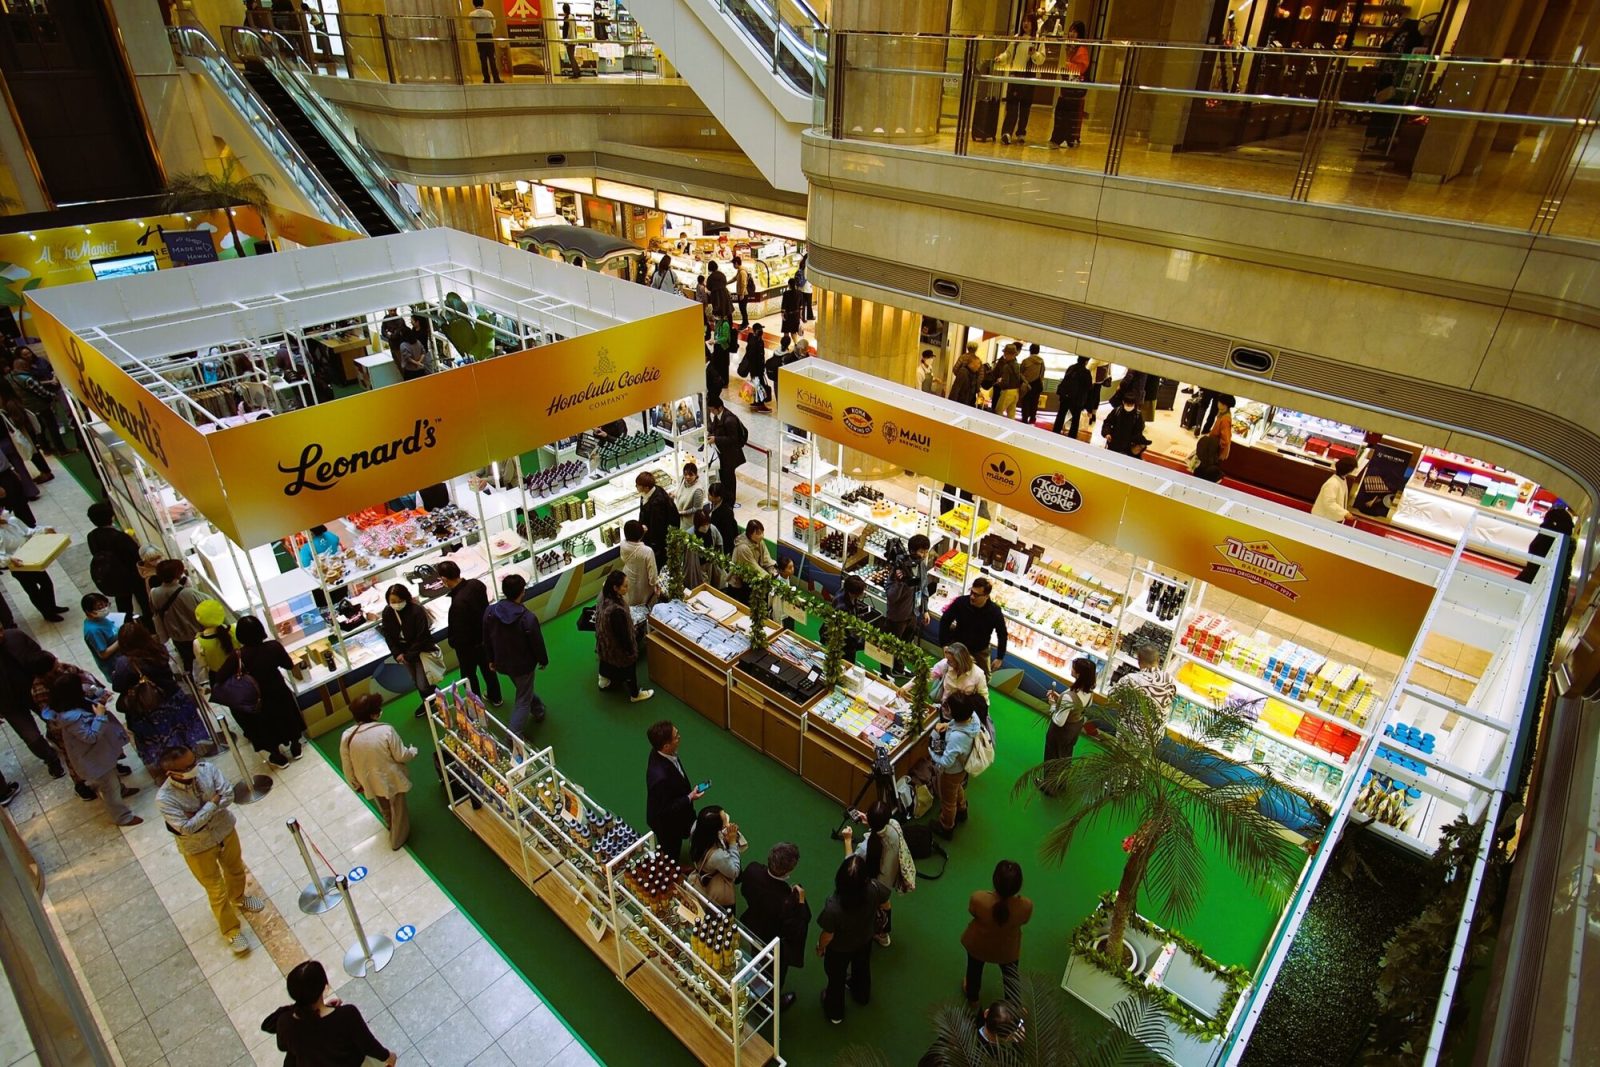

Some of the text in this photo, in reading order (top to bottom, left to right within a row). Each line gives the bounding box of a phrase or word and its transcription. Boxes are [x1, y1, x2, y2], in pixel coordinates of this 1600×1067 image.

[62, 336, 168, 468] Leonard's
[546, 367, 661, 417] Honolulu Cookie
[589, 394, 625, 410] COMPANY
[900, 427, 931, 448] MAUI
[278, 418, 437, 496] Leonard's
[1033, 487, 1074, 511] Kookie
[1037, 478, 1075, 499] Kauai
[1225, 538, 1298, 579] Diamond
[1237, 570, 1262, 583] ORIGINAL
[1264, 580, 1279, 590] SINCE
[1241, 563, 1272, 578] BAKERY
